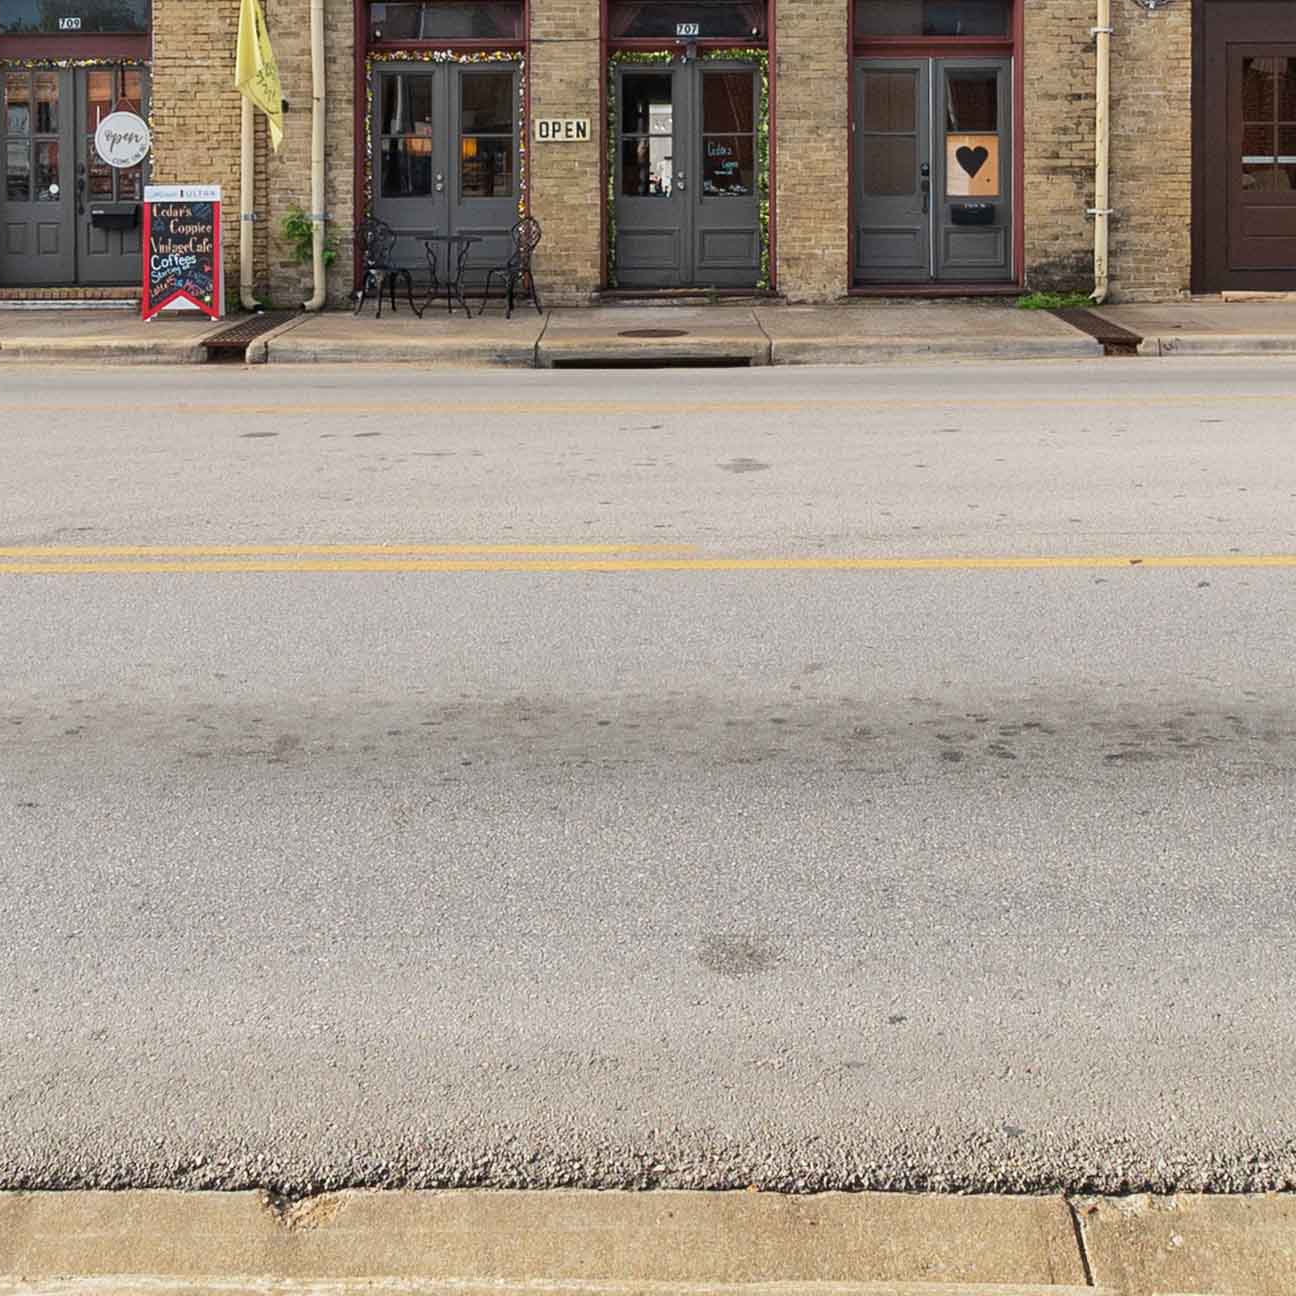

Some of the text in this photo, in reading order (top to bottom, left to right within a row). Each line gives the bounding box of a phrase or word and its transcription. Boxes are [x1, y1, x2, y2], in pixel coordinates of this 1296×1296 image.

[677, 24, 699, 35] 707
[539, 121, 587, 139] OPEN
[169, 218, 213, 235] Coppice
[151, 254, 197, 271] Coffees
